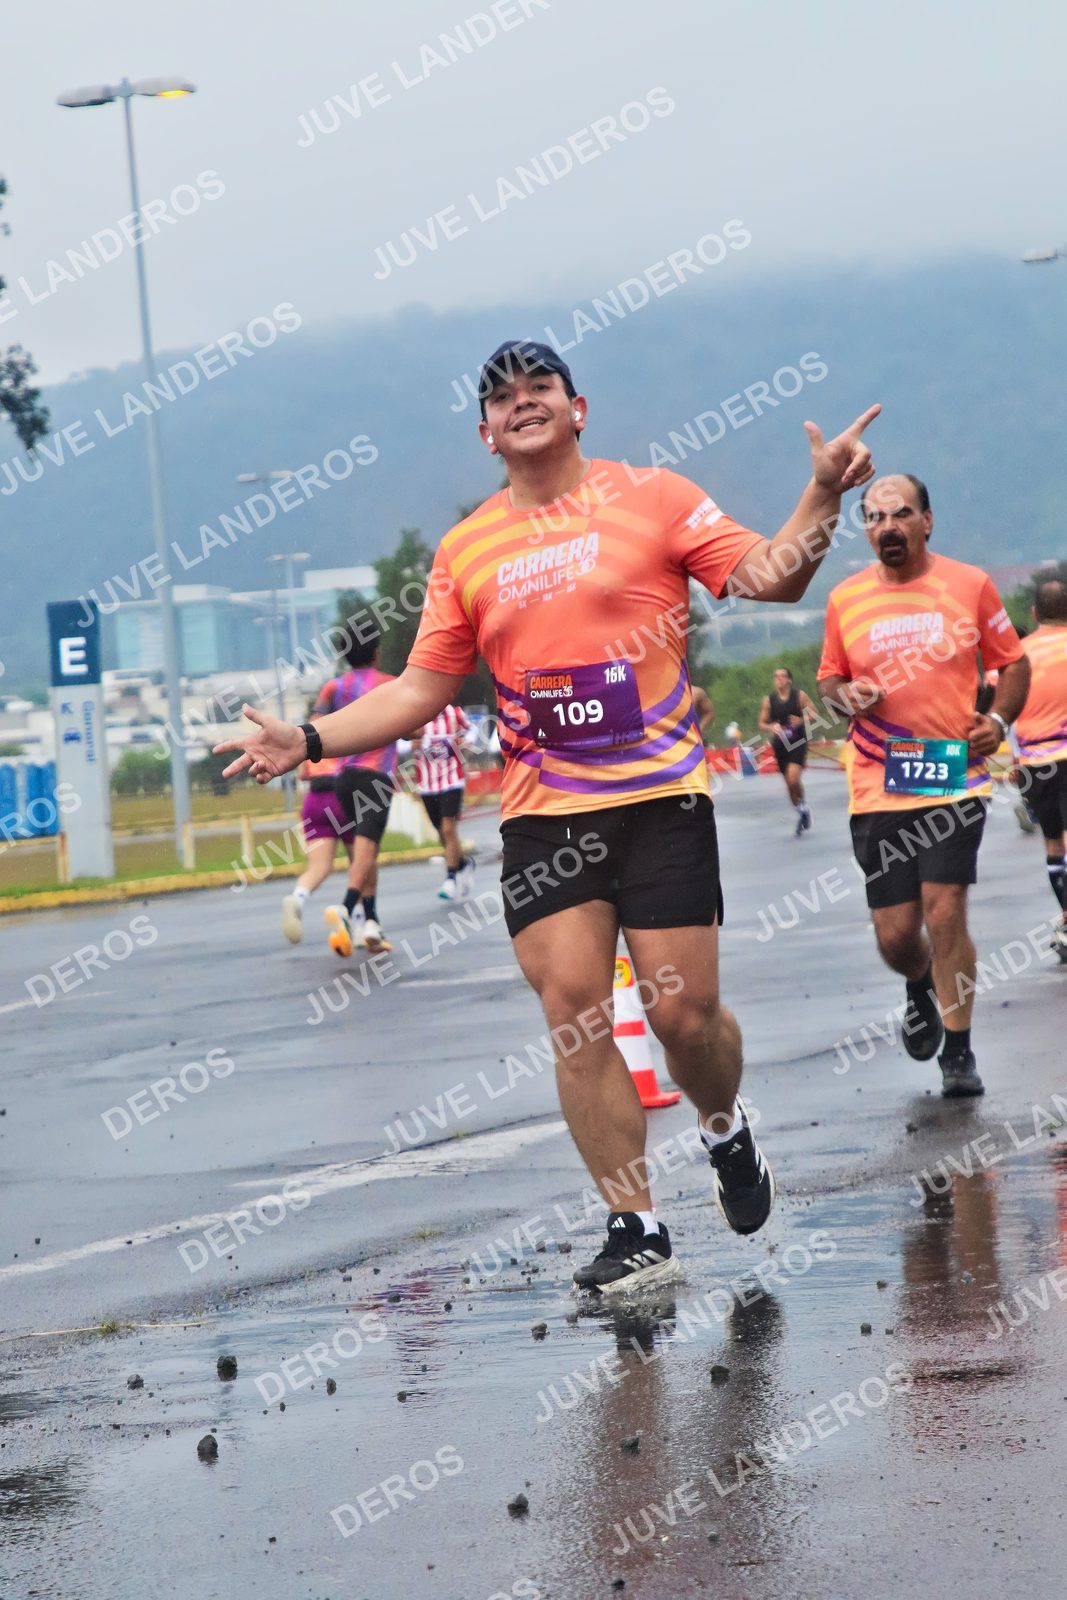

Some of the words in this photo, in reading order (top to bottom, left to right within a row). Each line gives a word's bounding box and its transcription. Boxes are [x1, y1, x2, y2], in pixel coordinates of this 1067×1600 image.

[497, 531, 599, 586] CARRERA
[870, 612, 943, 641] CARRERA
[59, 637, 88, 676] E
[530, 675, 573, 689] CARRERA
[553, 700, 604, 726] 109
[901, 761, 949, 780] 1723
